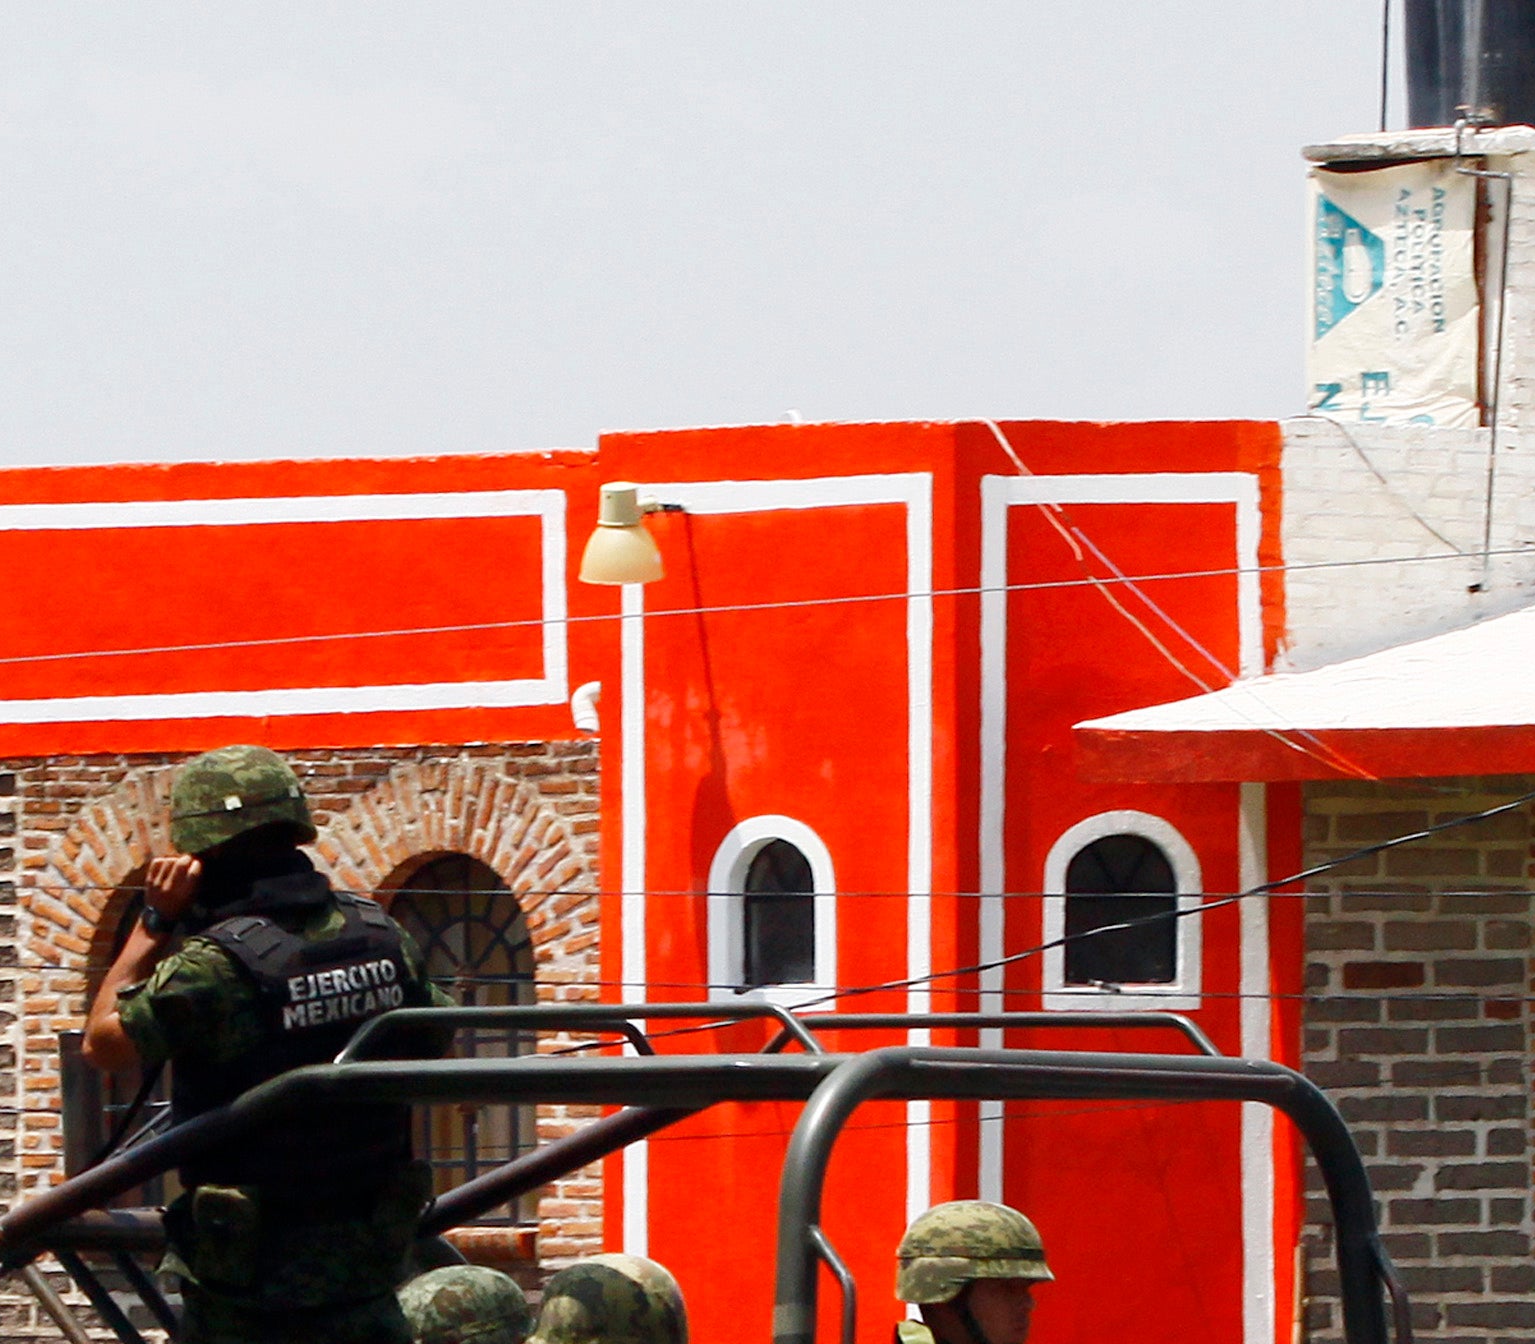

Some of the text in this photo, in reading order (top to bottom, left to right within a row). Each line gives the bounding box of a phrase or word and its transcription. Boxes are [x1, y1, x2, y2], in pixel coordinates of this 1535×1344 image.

[1409, 208, 1426, 314] POLITICA
[1429, 186, 1446, 333] AGRUPACION
[283, 985, 404, 1030] MEXICANO
[288, 958, 396, 1002] EJERCITO
